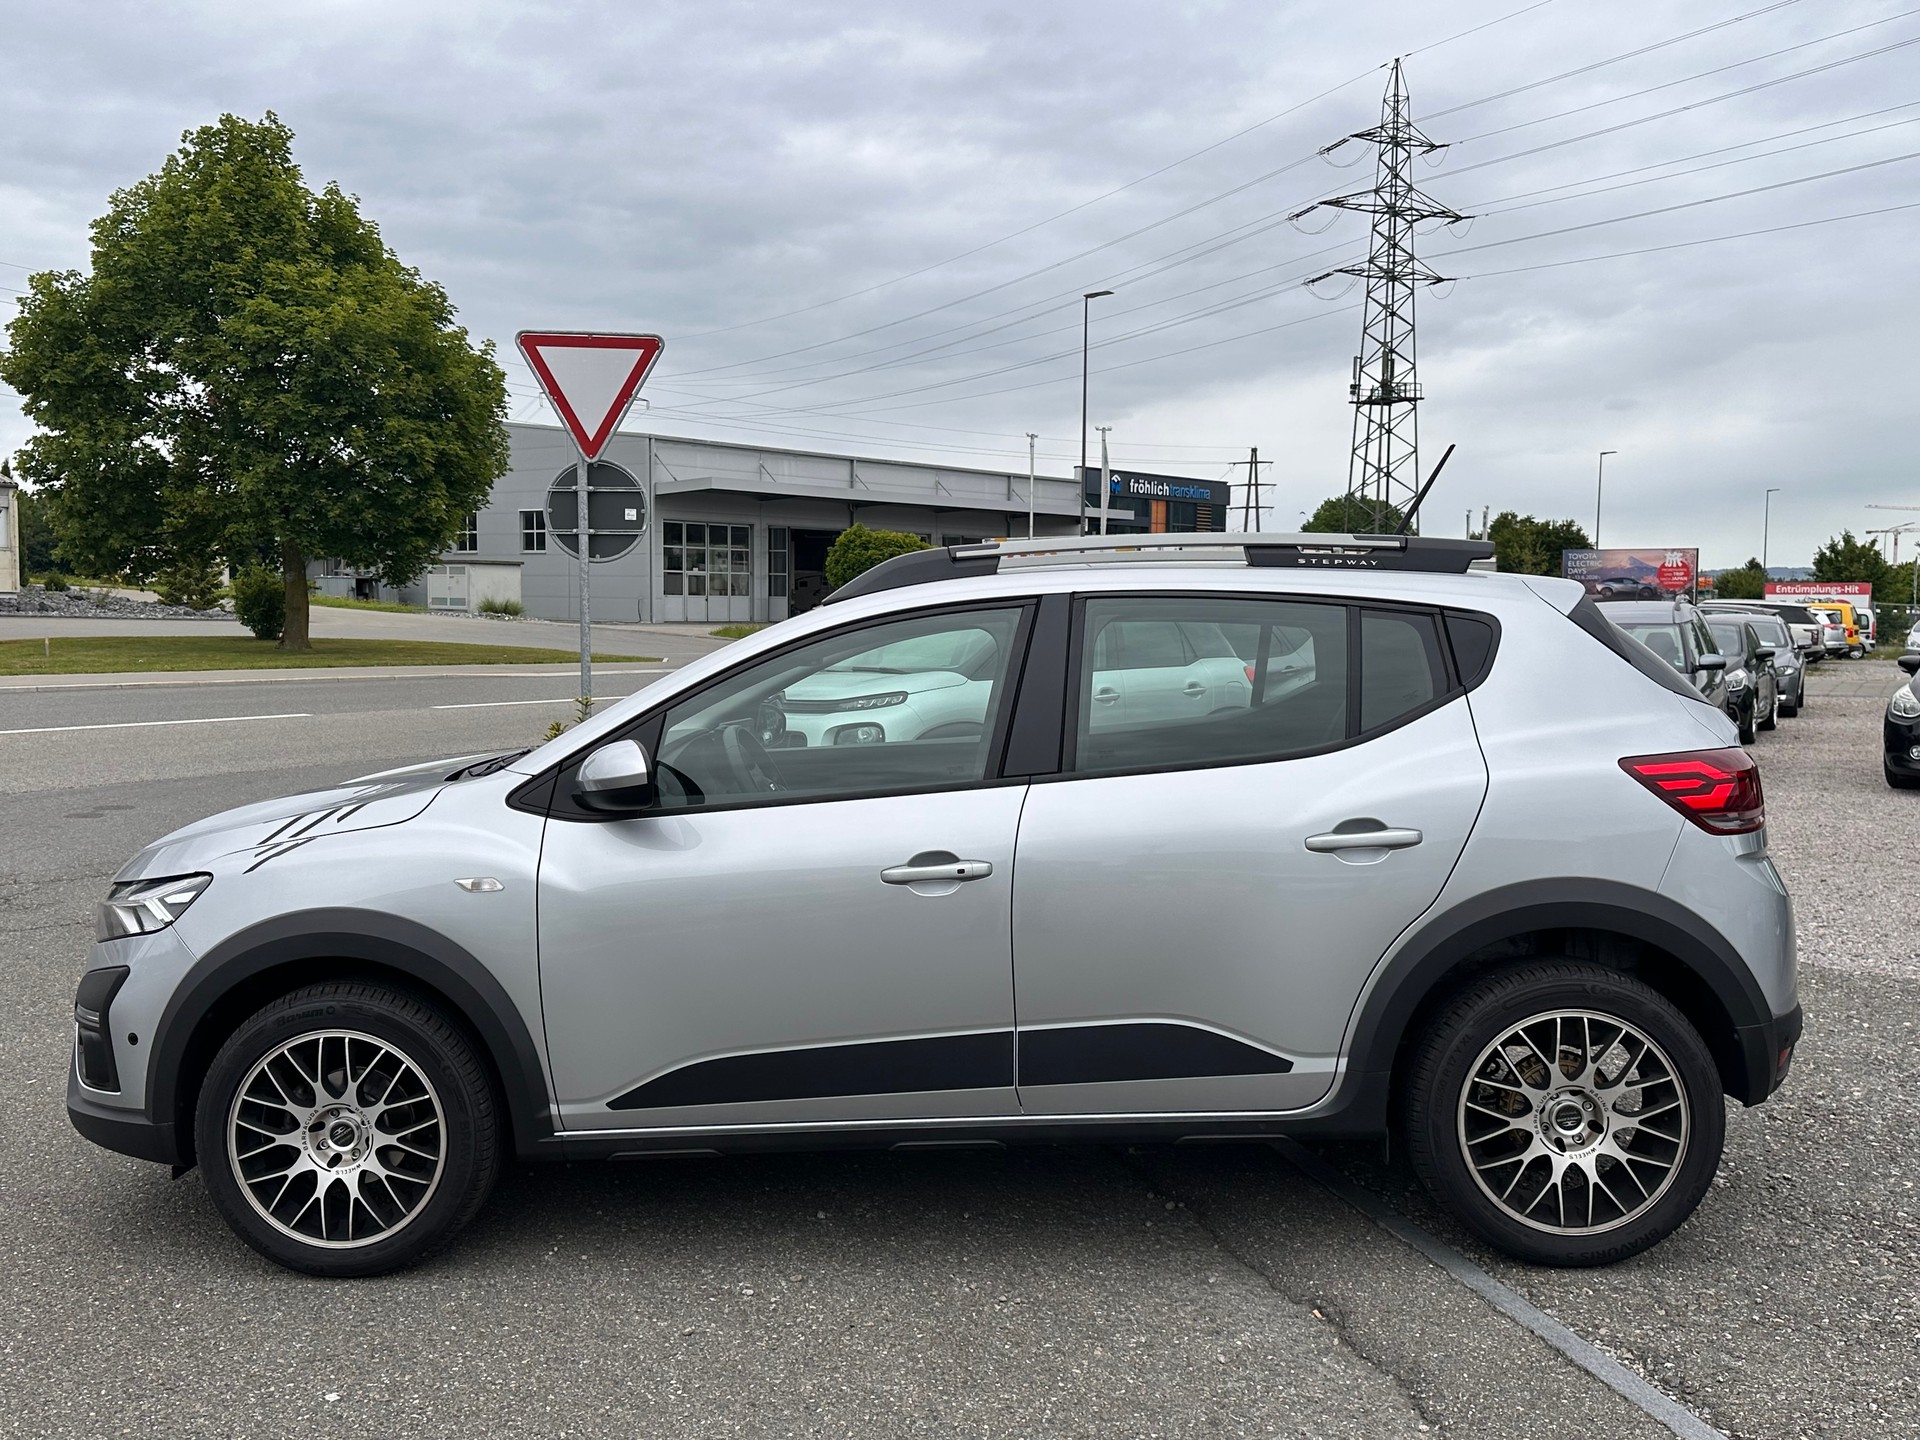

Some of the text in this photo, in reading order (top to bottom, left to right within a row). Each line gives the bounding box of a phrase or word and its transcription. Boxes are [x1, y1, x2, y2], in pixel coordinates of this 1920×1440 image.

[1297, 558, 1378, 566] STEPWAY
[1775, 584, 1860, 595] Entrümplungs-Hit
[1589, 1089, 1609, 1112] RACING
[355, 1107, 373, 1130] RACING
[1533, 1091, 1551, 1135] BARRACUDA
[301, 1109, 319, 1151] BARRACUDA
[1568, 1147, 1597, 1160] WHEELS
[335, 1163, 362, 1175] WHEELS
